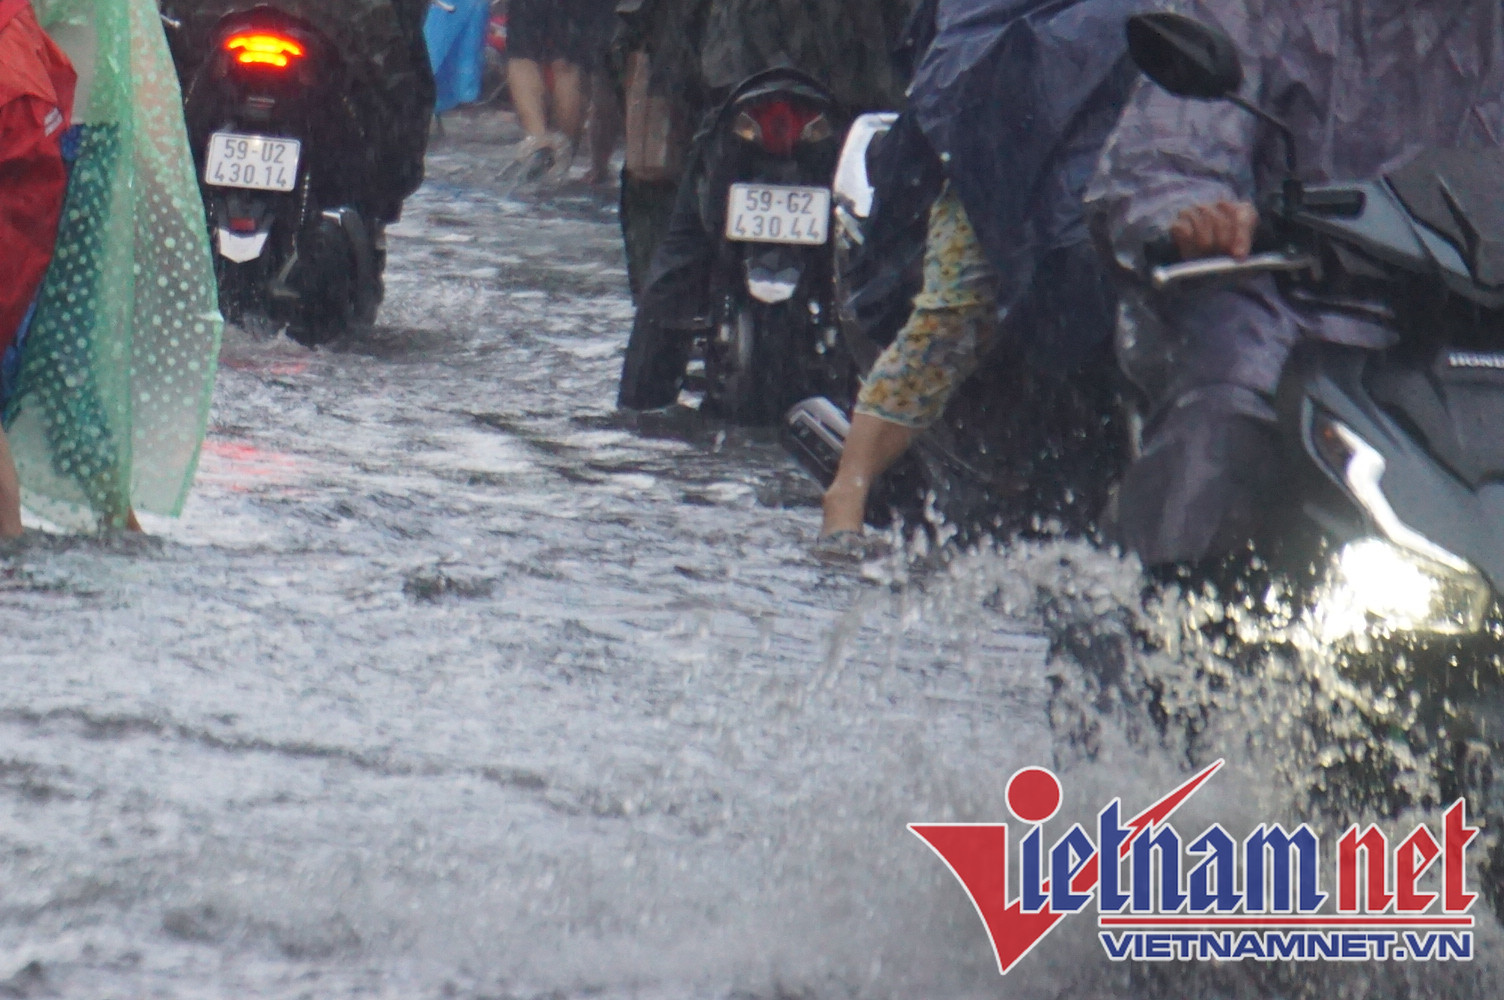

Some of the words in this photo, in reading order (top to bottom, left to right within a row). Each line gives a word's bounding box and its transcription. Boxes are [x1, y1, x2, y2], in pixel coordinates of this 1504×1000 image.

[224, 139, 286, 164] 59-U2
[214, 162, 287, 187] 430.14
[735, 214, 820, 239] 430.44
